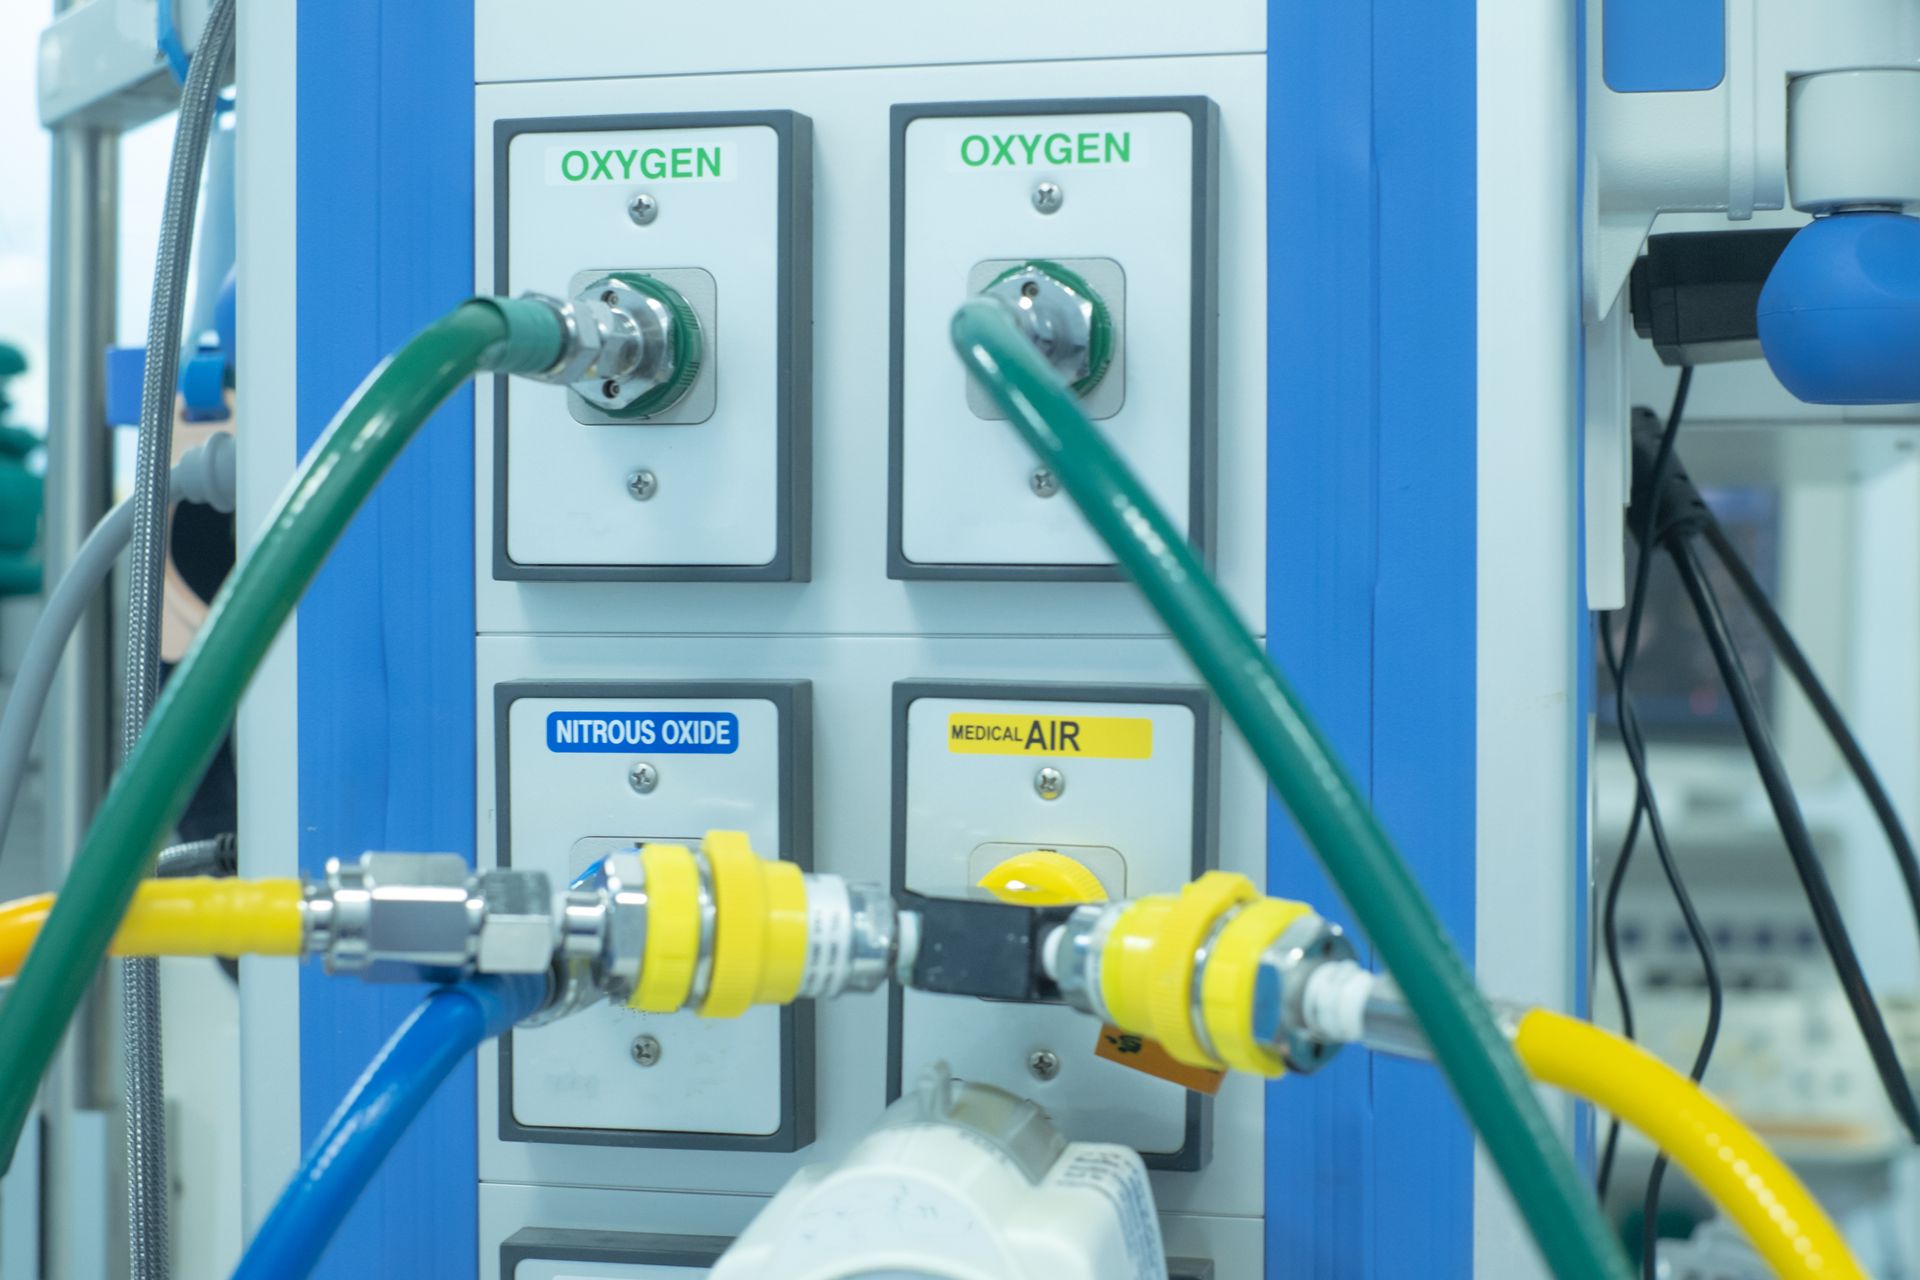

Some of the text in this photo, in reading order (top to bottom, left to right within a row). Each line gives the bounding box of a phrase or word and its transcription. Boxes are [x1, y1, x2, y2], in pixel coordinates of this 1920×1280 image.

[561, 146, 721, 182] OXYGEN
[960, 132, 1131, 168] OXYGEN
[556, 719, 731, 745] NITROUS OXIDE
[951, 719, 1081, 751] MEDICAL AIR
